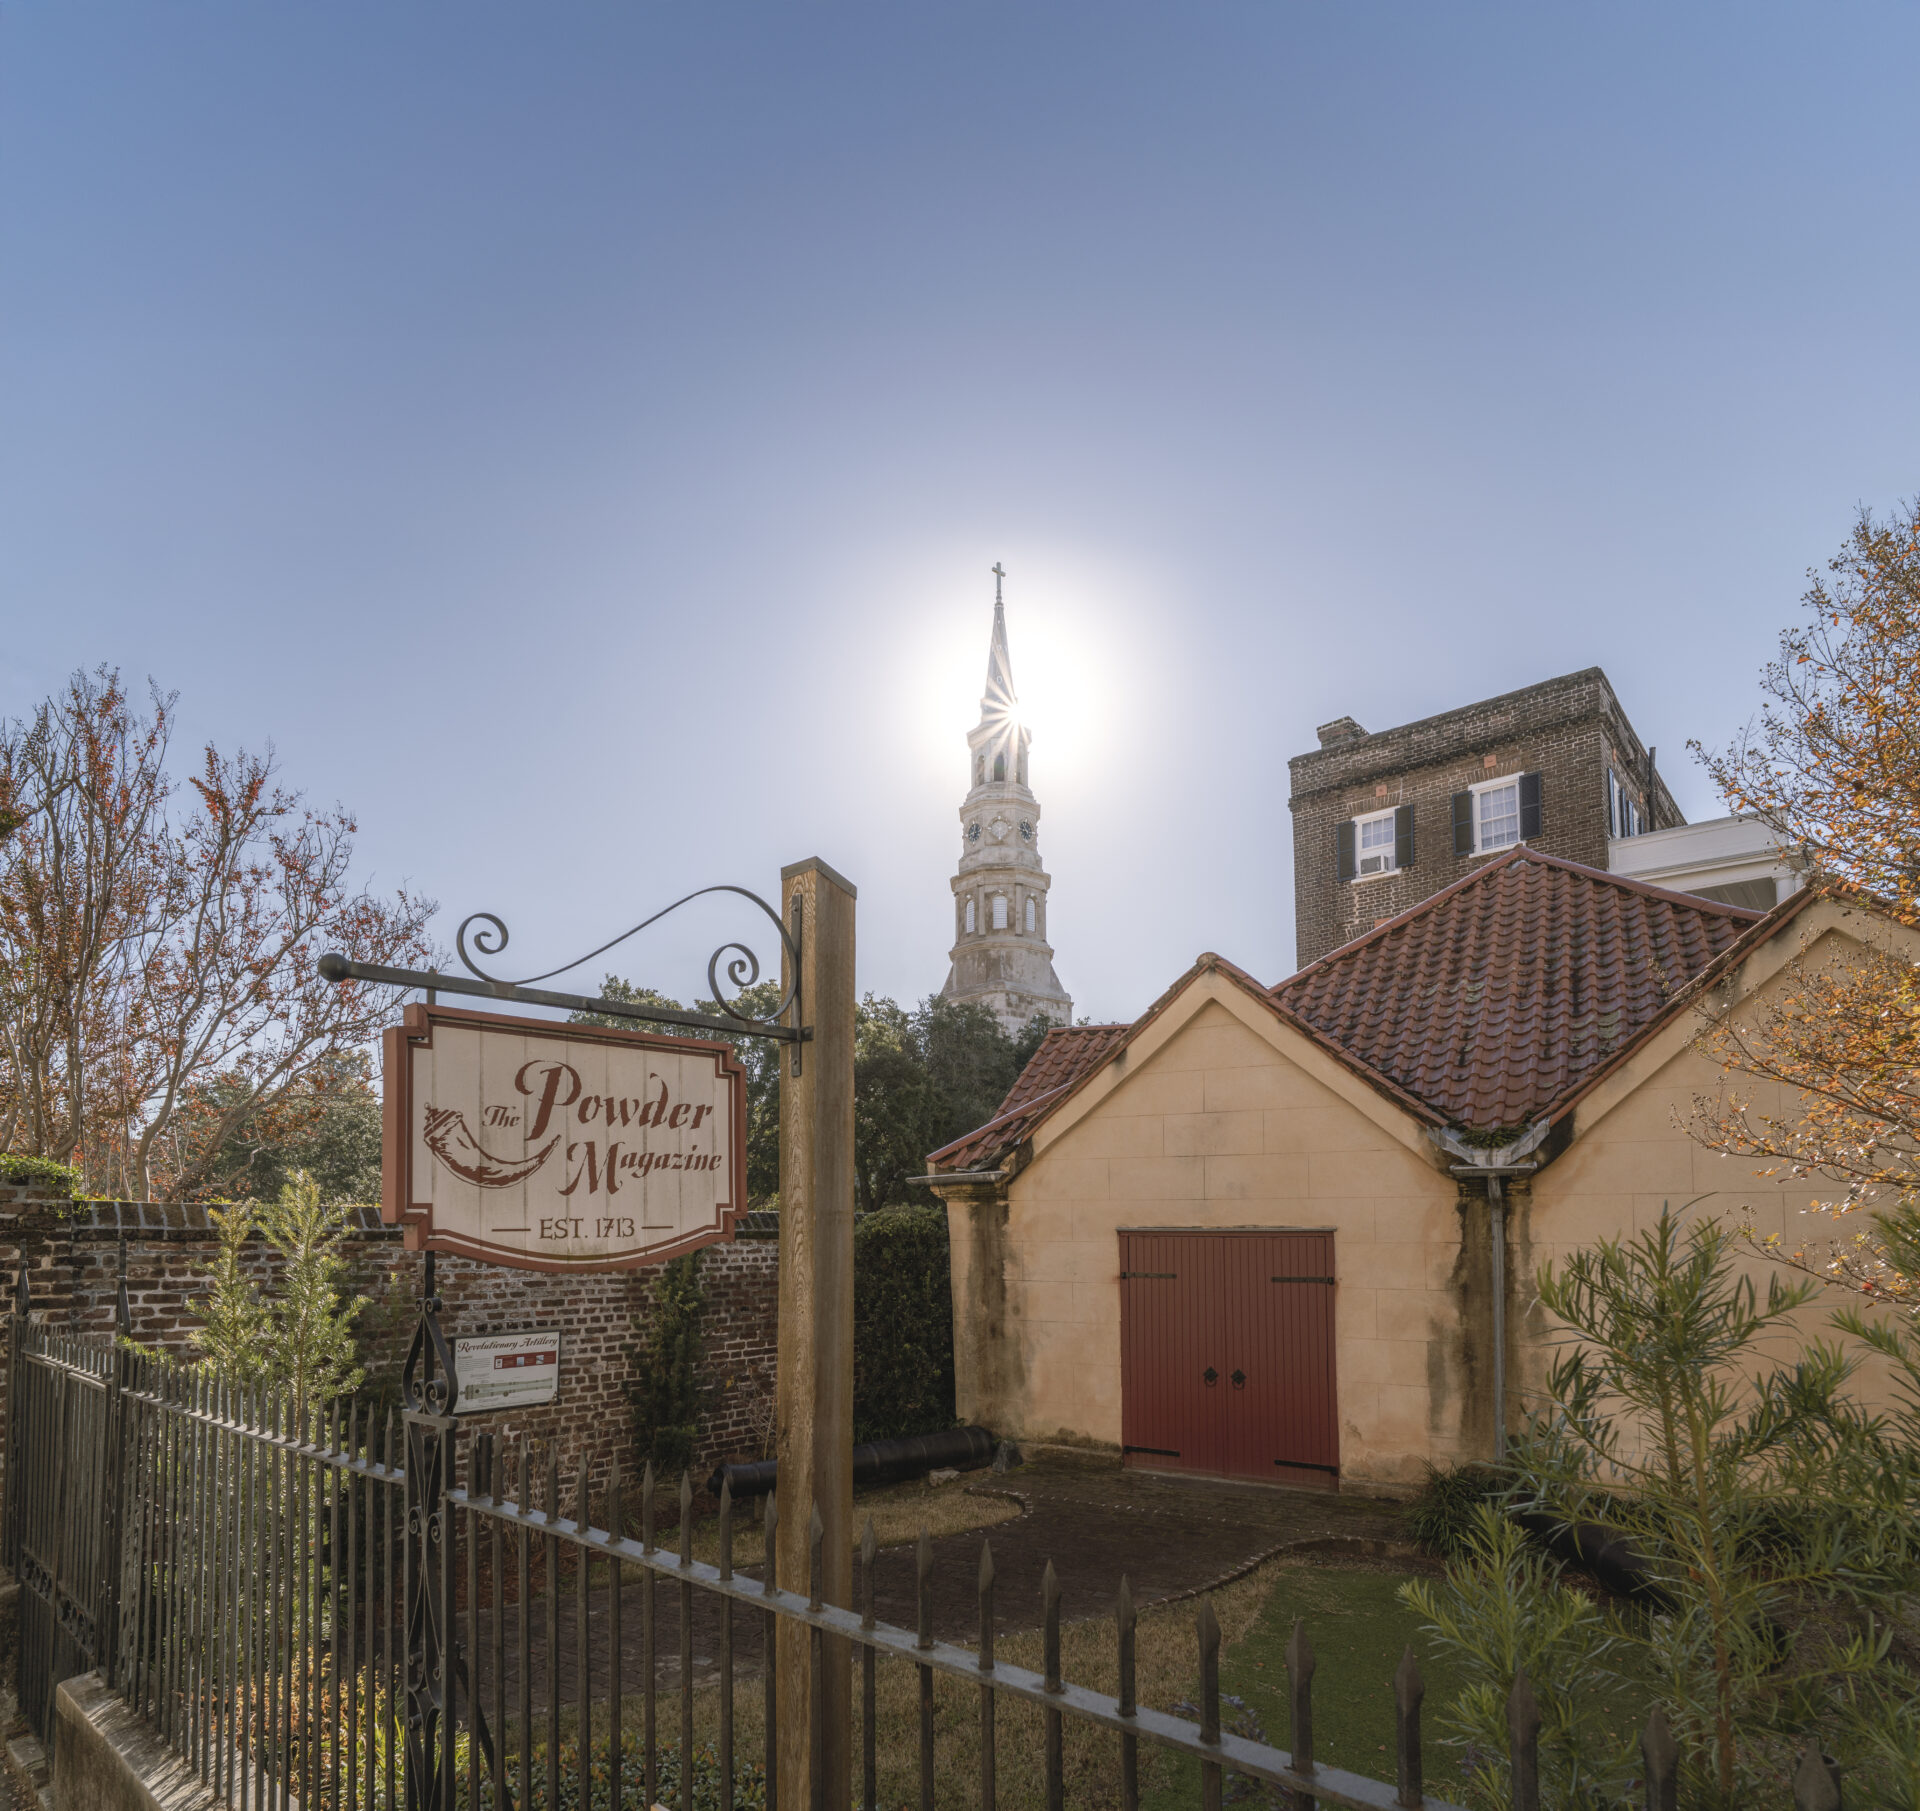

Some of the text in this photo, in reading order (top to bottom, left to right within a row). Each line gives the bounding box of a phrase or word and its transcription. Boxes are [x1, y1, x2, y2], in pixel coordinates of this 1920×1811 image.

[482, 1060, 713, 1141] The Powder
[556, 1141, 721, 1196] Magazine
[539, 1217, 635, 1239] EST. 1713
[457, 1336, 557, 1352] Revolutionary Artillery
